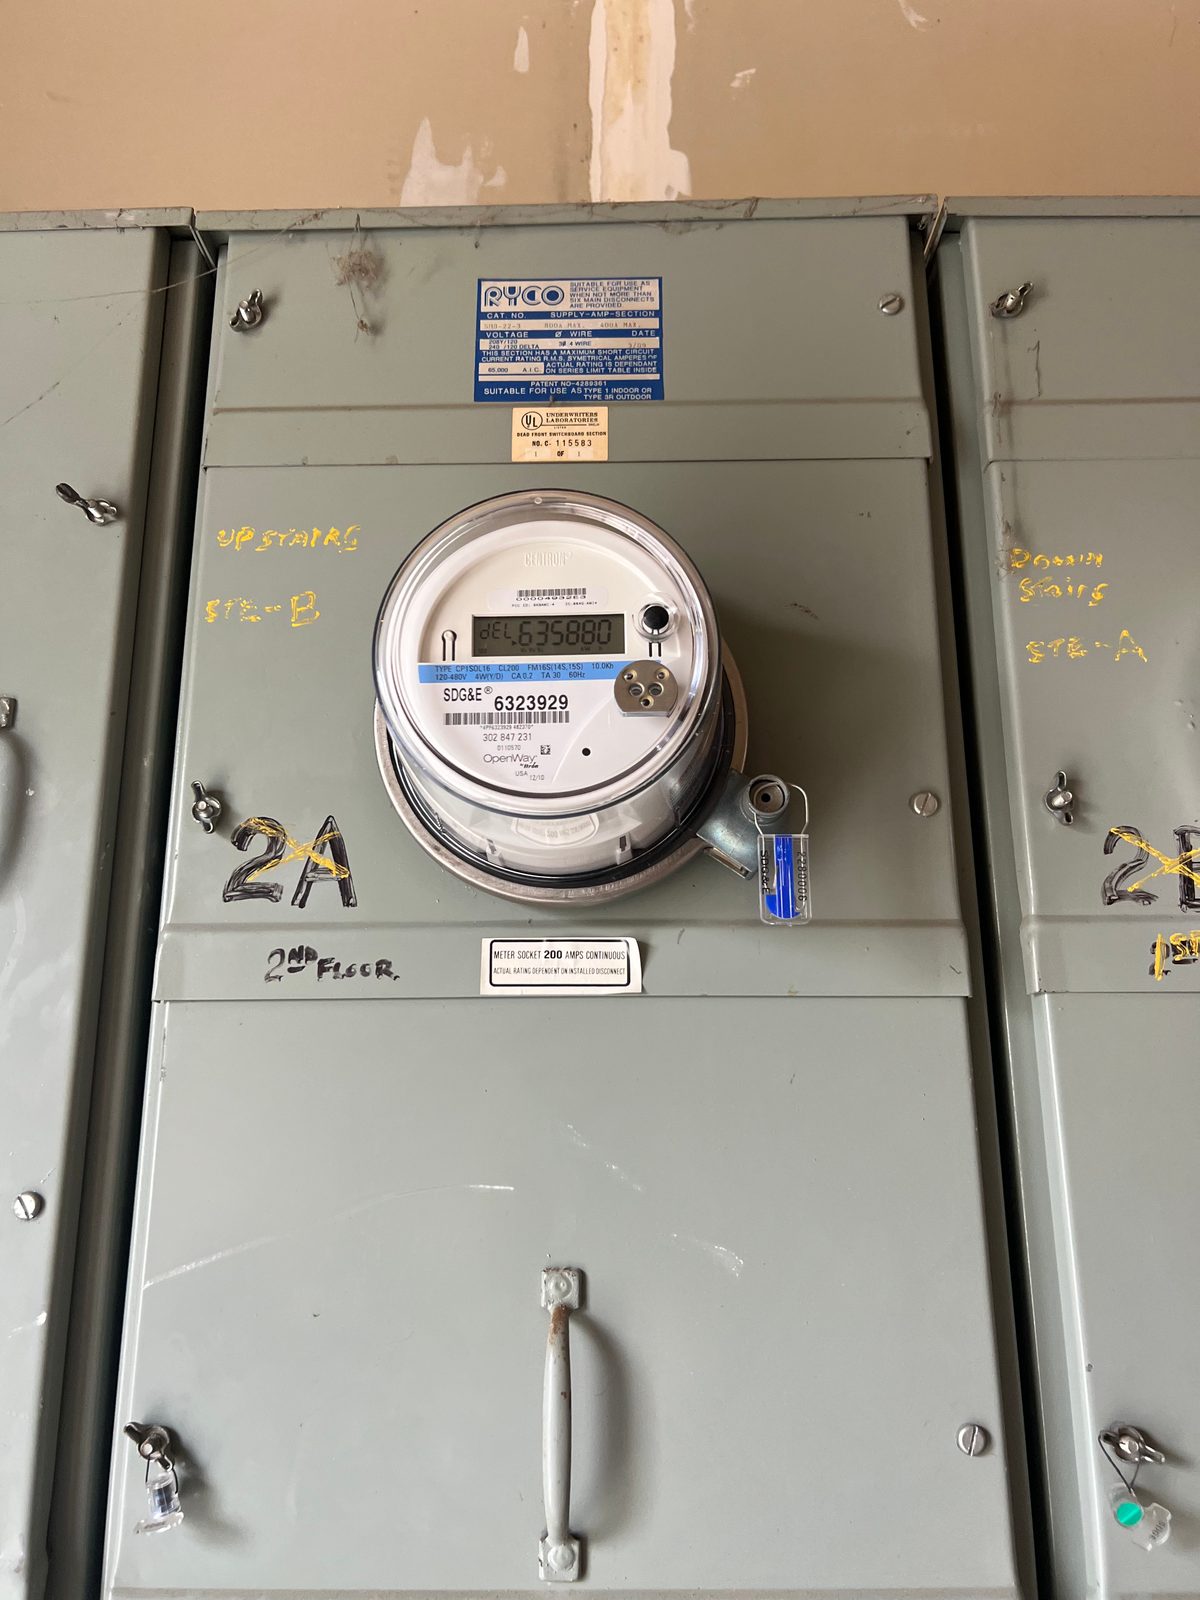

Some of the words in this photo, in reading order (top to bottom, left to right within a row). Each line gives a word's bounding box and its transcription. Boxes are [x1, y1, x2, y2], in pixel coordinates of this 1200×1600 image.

[484, 286, 564, 306] RYCO
[526, 415, 538, 427] UL
[518, 619, 612, 646] 635880
[498, 664, 520, 672] CL200
[494, 695, 569, 711] 6323929
[500, 733, 515, 741] 847
[518, 733, 532, 741] 231
[483, 754, 536, 764] OpenWay
[223, 815, 358, 909] 2A
[494, 951, 515, 959] METER
[518, 951, 541, 959] SOCKET
[544, 950, 562, 959] 200
[565, 951, 584, 959] AMPS
[586, 951, 625, 959] CONTINUOUS
